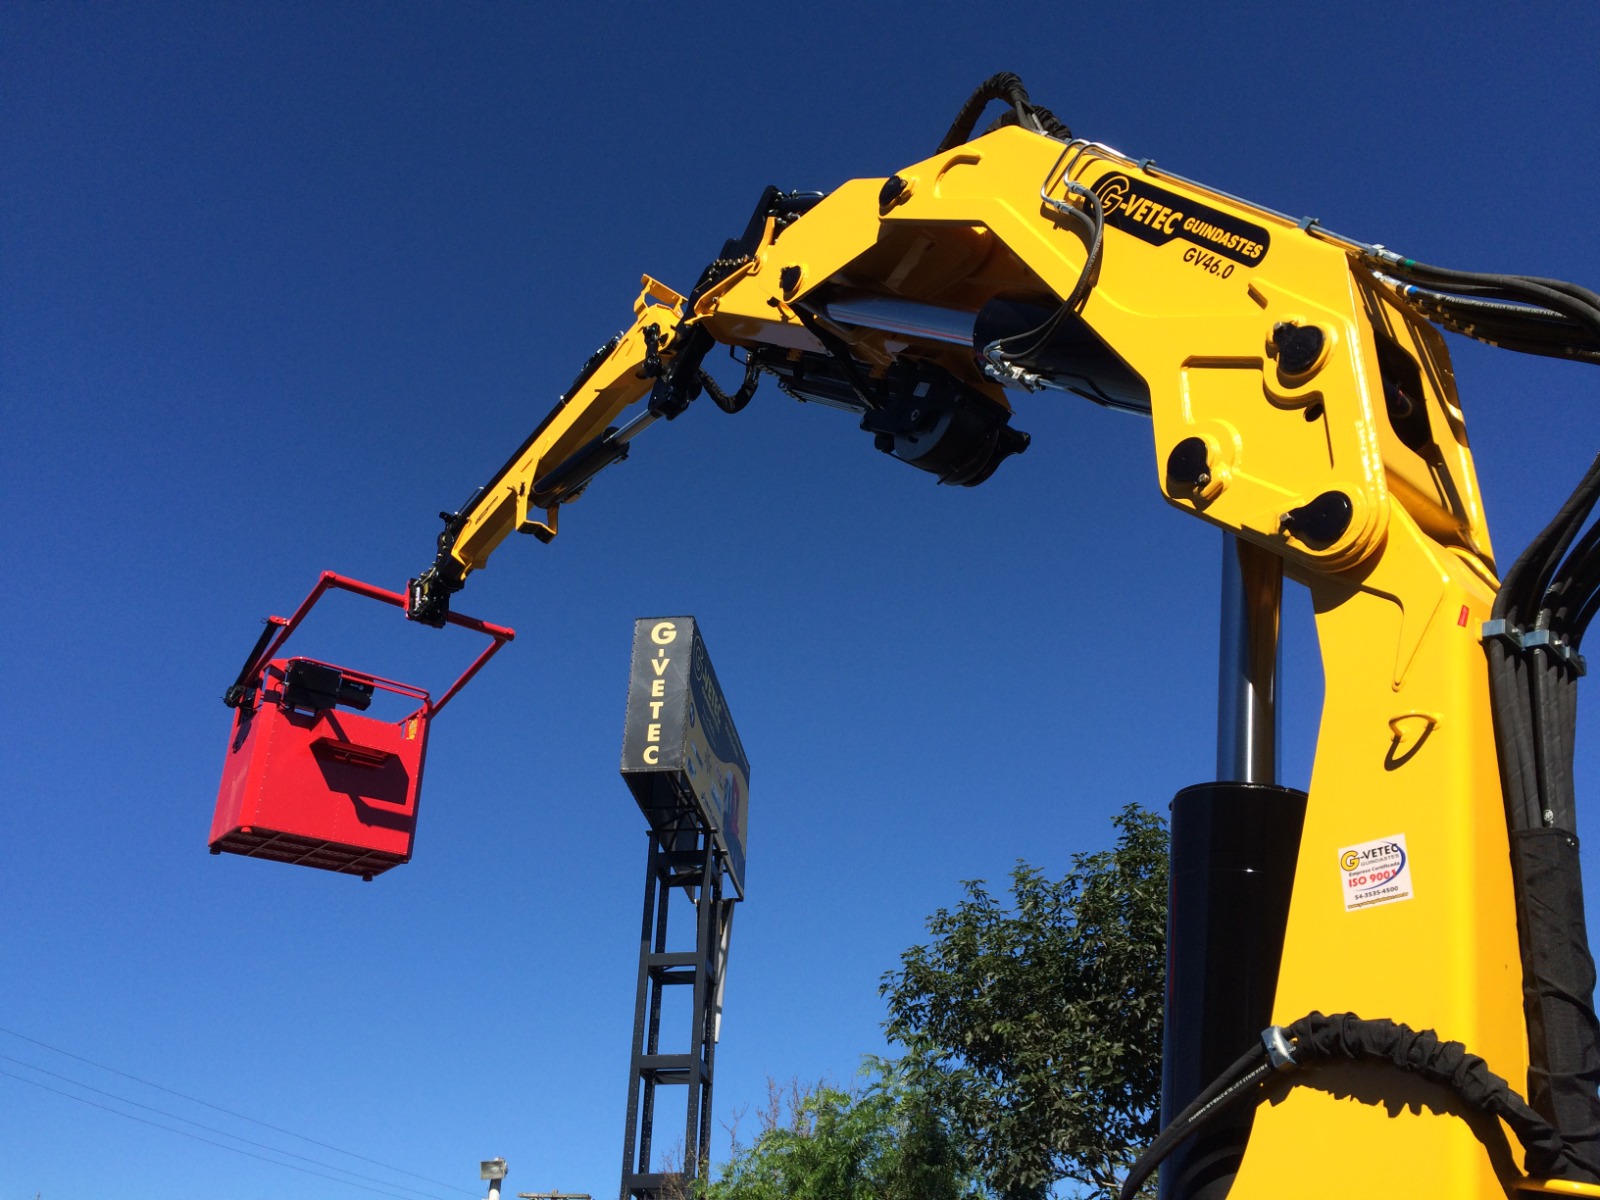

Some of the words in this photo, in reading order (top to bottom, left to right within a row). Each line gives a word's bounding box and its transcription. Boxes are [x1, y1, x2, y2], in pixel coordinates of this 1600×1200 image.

[1092, 174, 1183, 235] G-VETEC
[1183, 216, 1264, 259] GUINDASTES
[1183, 247, 1235, 280] GV46.0
[1340, 843, 1399, 872] G-VETEC
[1360, 853, 1400, 866] GUINDASTES
[1348, 876, 1367, 888] ISO
[1369, 868, 1397, 882] 9001
[1354, 885, 1399, 900] 54-3535-4500
